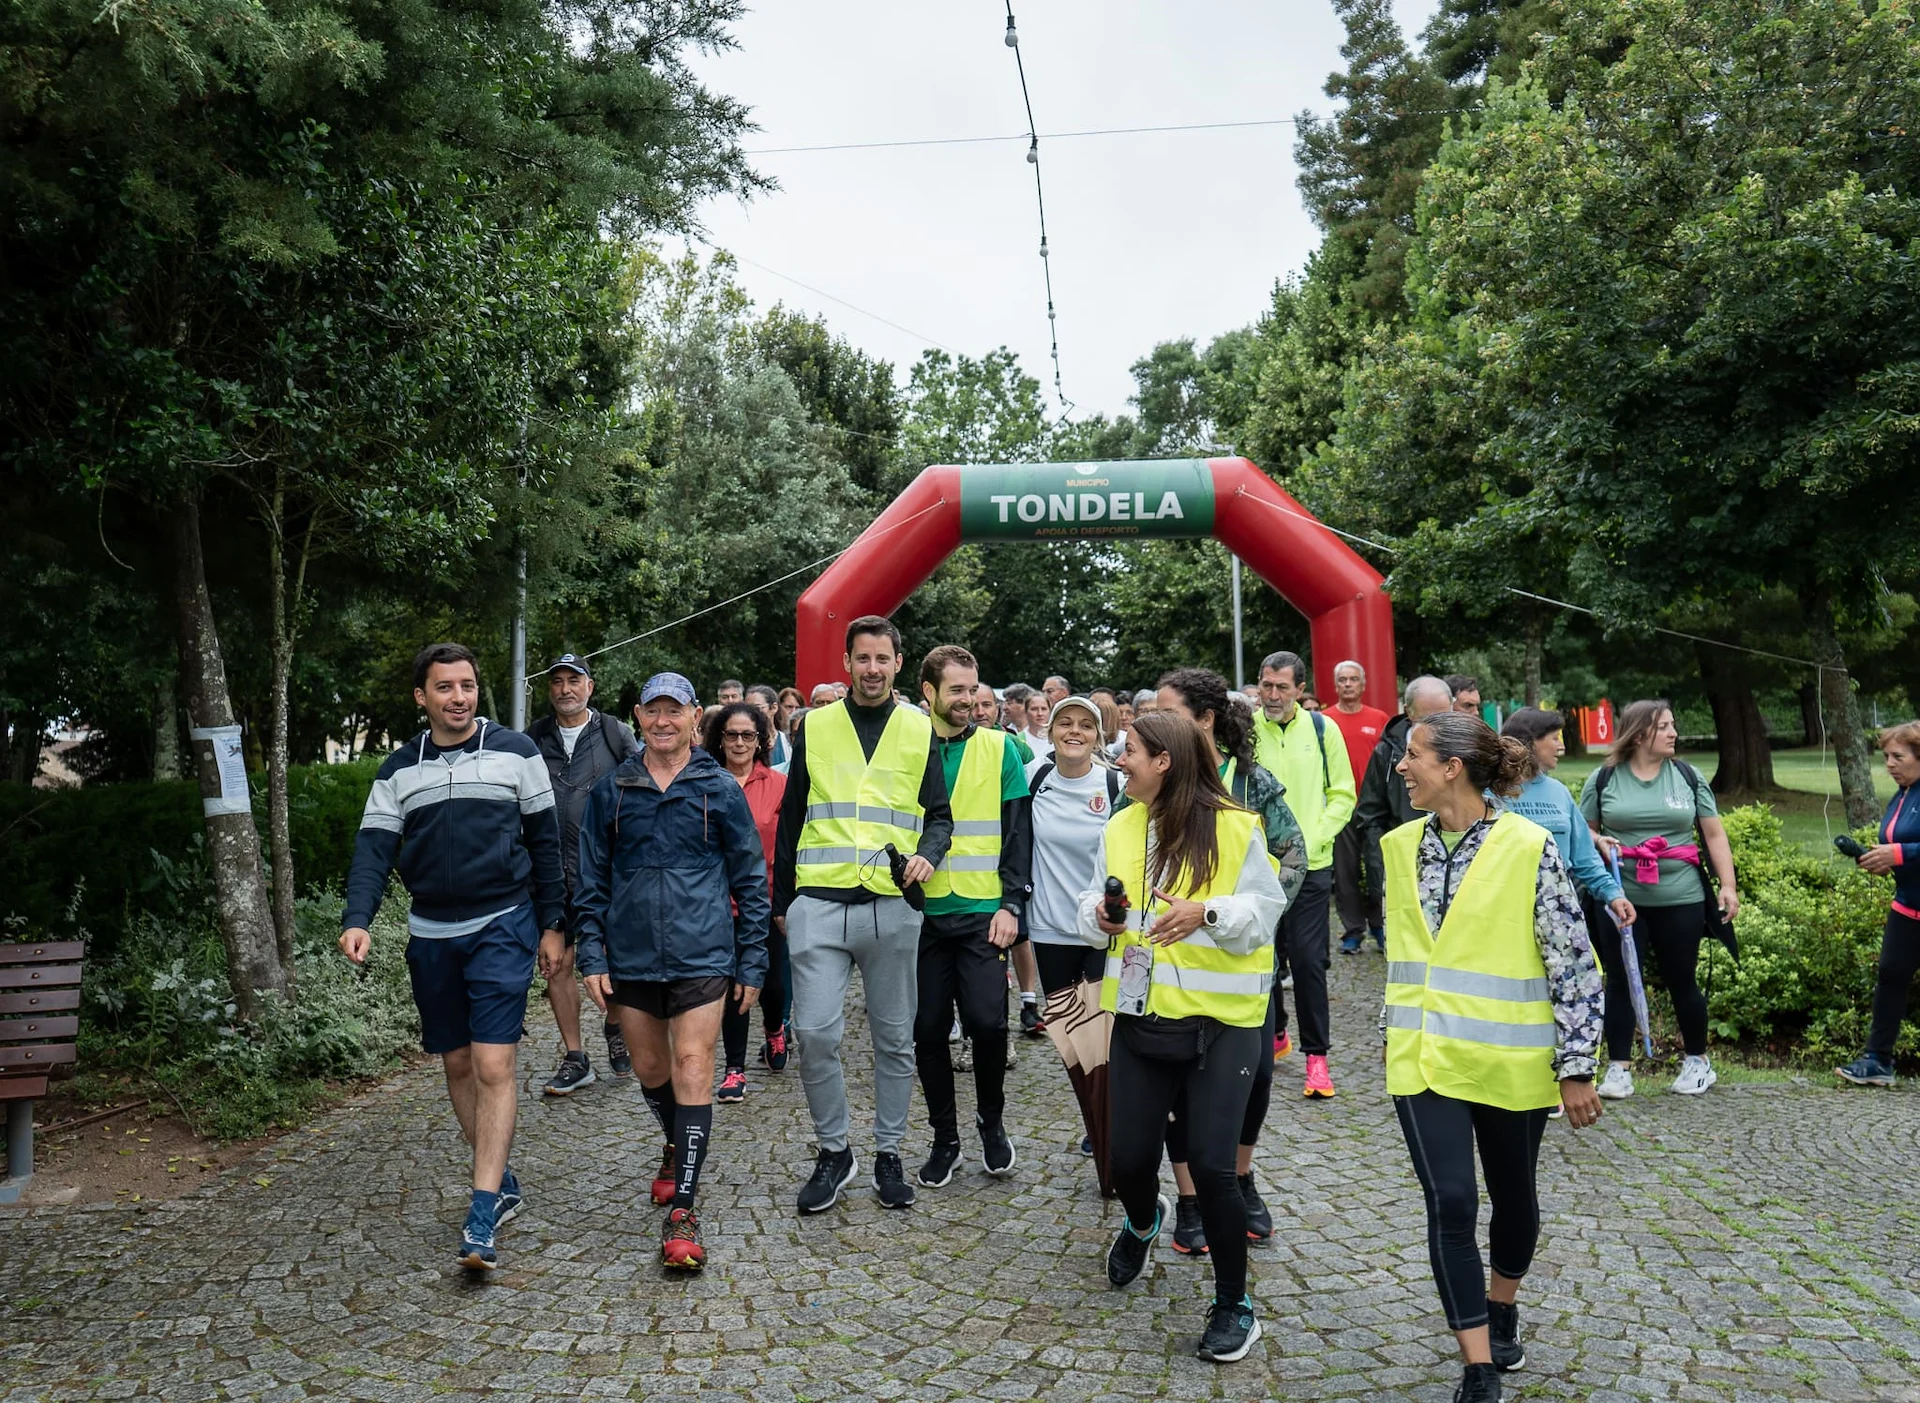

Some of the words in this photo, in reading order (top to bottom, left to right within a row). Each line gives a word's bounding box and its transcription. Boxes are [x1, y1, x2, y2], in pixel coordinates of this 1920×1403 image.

[990, 491, 1184, 522] TONDELA
[1034, 527, 1067, 536] APOIA
[1069, 527, 1078, 535] O
[1080, 526, 1139, 535] DESPORTO
[679, 1125, 704, 1194] kalenji
